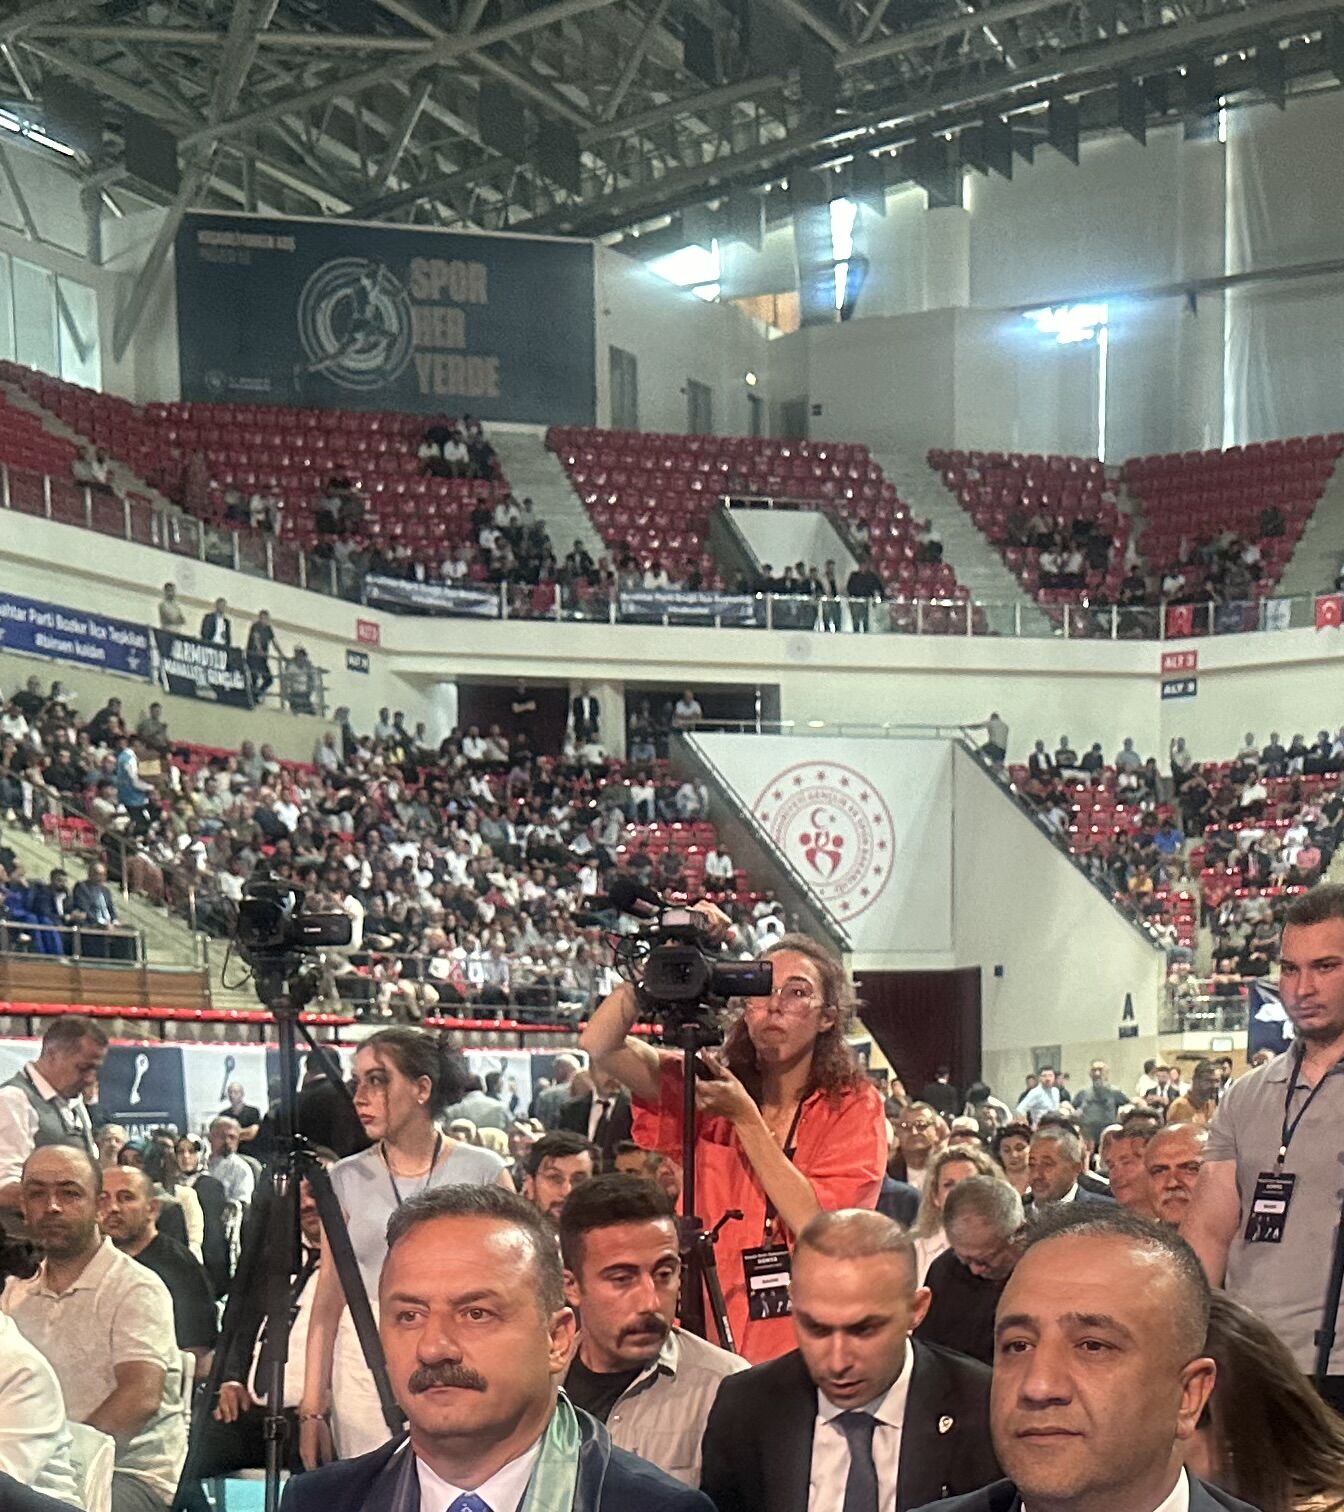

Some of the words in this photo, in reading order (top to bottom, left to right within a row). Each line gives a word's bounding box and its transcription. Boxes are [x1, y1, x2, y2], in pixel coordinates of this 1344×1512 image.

[411, 257, 488, 304] SPOR
[413, 353, 501, 398] YERDE
[1122, 992, 1135, 1021] A
